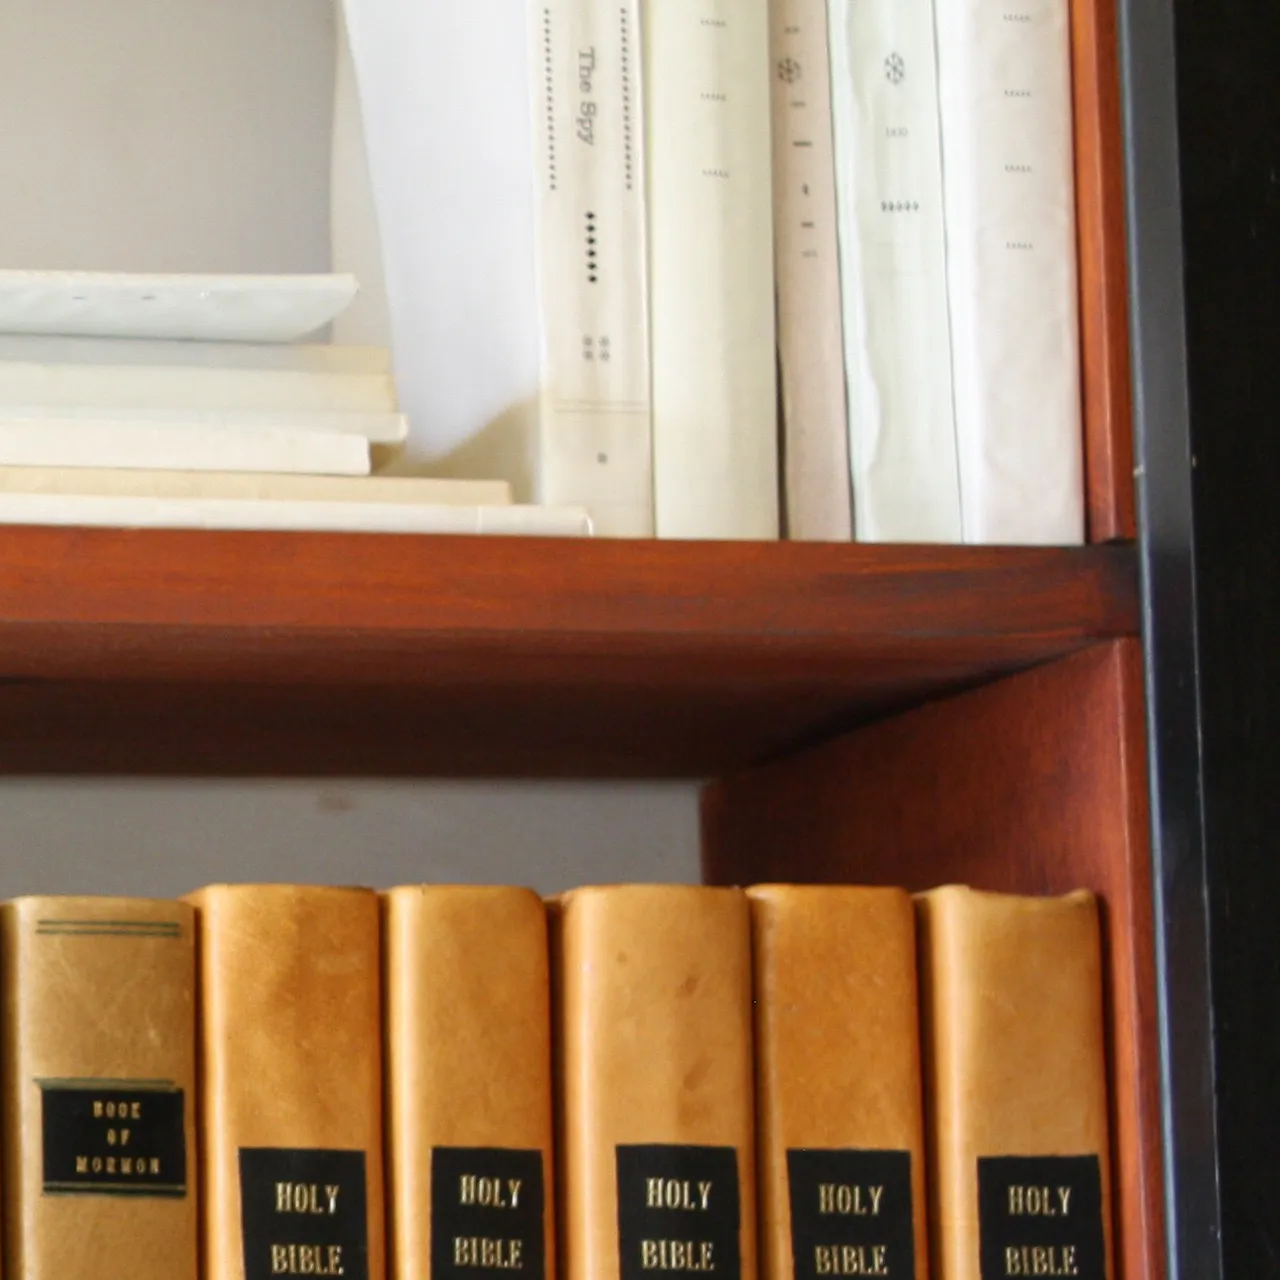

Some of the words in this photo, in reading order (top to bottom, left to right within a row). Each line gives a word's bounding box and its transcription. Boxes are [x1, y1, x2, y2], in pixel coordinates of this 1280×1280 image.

[578, 46, 596, 93] The
[575, 101, 597, 146] Spy
[93, 1100, 140, 1119] BOOK
[106, 1128, 130, 1146] OF
[75, 1156, 160, 1174] MORMON
[276, 1182, 338, 1214] HOLY
[460, 1175, 521, 1208] HOLY
[647, 1177, 711, 1209] HOLY
[819, 1184, 883, 1214] HOLY
[1009, 1186, 1071, 1215] HOLY
[271, 1244, 344, 1275] BIBLE
[454, 1236, 522, 1268] BIBLE
[641, 1239, 714, 1270] BIBLE
[815, 1245, 888, 1275] BIBLE
[1005, 1245, 1078, 1276] BIBLE
